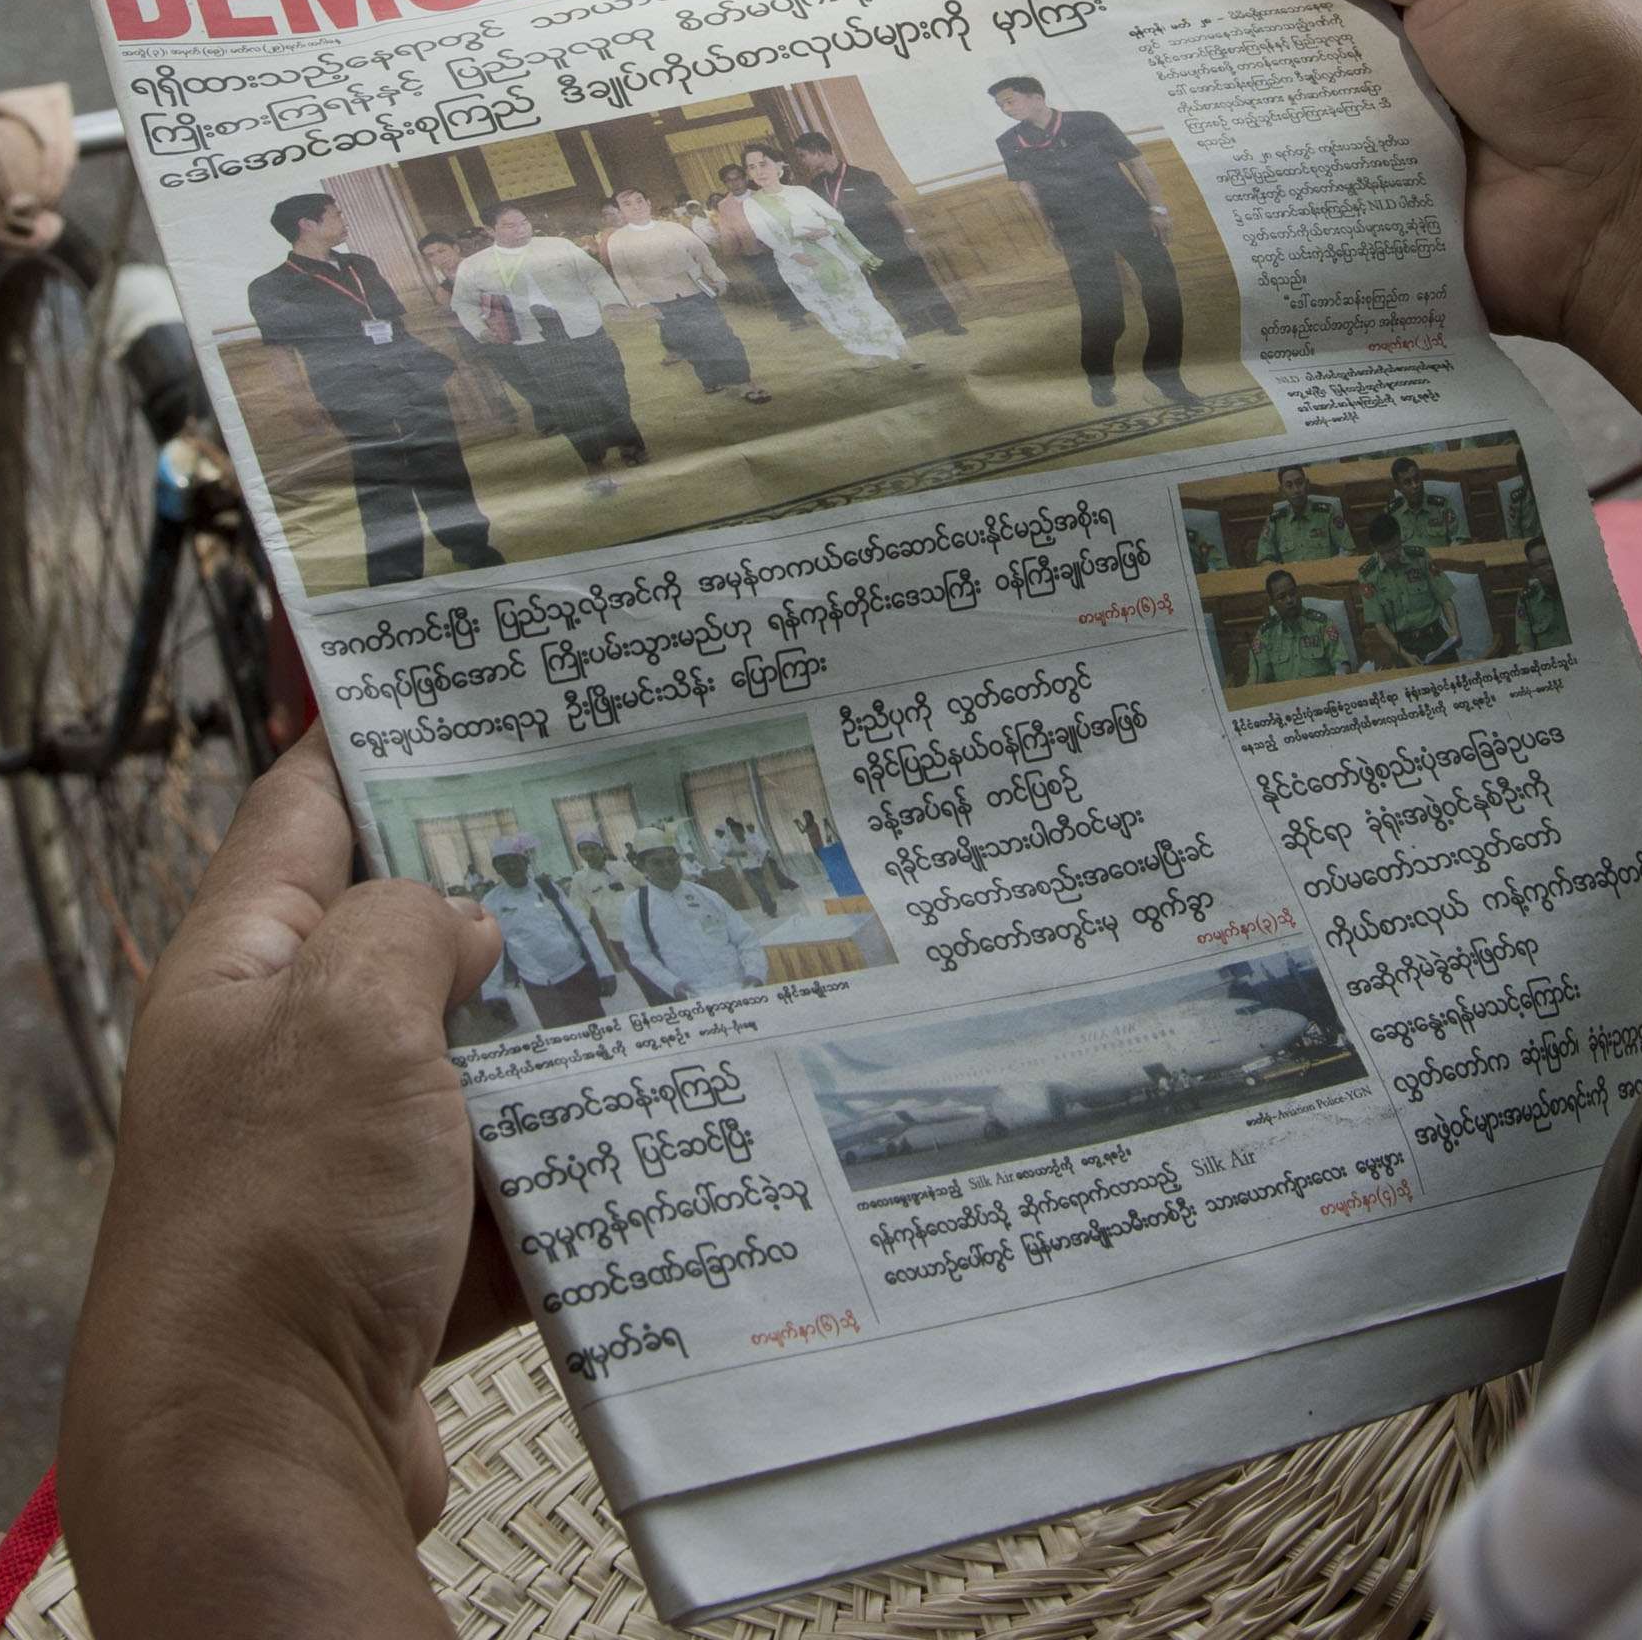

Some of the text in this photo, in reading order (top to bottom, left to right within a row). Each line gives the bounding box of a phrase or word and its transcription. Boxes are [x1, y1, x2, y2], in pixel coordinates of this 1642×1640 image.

[130, 19, 506, 108] ရရှိထားသည့်နေရာတွင်
[140, 69, 424, 157] ကြိုးစားကြရန်နှင့်
[445, 27, 655, 91] ပြည်သူလူထု
[159, 85, 542, 189] ဒေါ်အောင်ဆန်းစုကြည်
[555, 0, 973, 111] ဒီချုပ်ကိုယ်စားလှယ်များကို
[320, 498, 1118, 657] အဂတိကင်းပြီး ပြည်သူ့လိုအင်ကို အမှန်တကယ်ဖော်ဆောင်ပေးနိုင်မည့်အစိုးရ
[335, 537, 1152, 711] တစ်ရပ်ဖြစ်အောင် ကြိုးပမ်းသွားမည်ဟု ရန်ကုန်တိုင်းဒေသကြီး ဝန်ကြီးချုပ်အဖြစ်
[349, 645, 828, 759] ရွေးချယ်ခံထားရသူ ဦးဖြိုးမင်းသိန်း ပြောကြား
[838, 660, 1093, 749] ဦးညီပုကို လွှတ်တော်တွင်
[852, 699, 1148, 796] ရခိုင်ပြည်နယ်ဝန်ကြီးချုပ်အဖြစ်
[1257, 725, 1566, 812] နိုင်ငံတော်ဖွဲ့စည်းပုံအခြေခံဥပဒေ
[866, 763, 1084, 841] ခန့်အပ်ရန် တင်ပြစဉ်
[1281, 768, 1555, 858] ဆိုင်ရာ ခုံရုံးအဖွဲ့ဝင်နှစ်ဦးကို
[884, 806, 1146, 886] ရခိုင်အမျိုးသားပါတီဝင်များ
[905, 830, 1215, 927] လွှတ်တော်အစည်းအဝေးမပြီးခင်
[1303, 817, 1563, 900] တပ်မတော်သားလွှတ်တော်
[925, 886, 1215, 973] လွှတ်တော်အတွင်းမှ ထွက်ခွာ
[1324, 888, 1470, 958] ကိုယ်စားလှယ်
[1346, 931, 1540, 1000] အဆိုကိုမဲခွဲဆုံးဖြတ်ရာ
[1369, 972, 1582, 1050] ဆွေးနွေးရန်မသင့်ကြောင်း
[478, 1059, 747, 1143] ဒေါ်အောင်ဆန်းစုကြည်
[1393, 1048, 1511, 1103] လွှတ်တော်က
[1520, 1028, 1580, 1080] ဆုံးဖြတ်၊
[1413, 1069, 1607, 1153] အဖွဲ့ဝင်များအမည်စာရင်းကို
[499, 1116, 755, 1198] ဓာတ်ပုံကို ပြင်ဆင်ပြီး
[967, 1174, 993, 1191] Silk
[995, 1171, 1016, 1186] Air
[1354, 1151, 1406, 1181] မွေးဖွား
[520, 1173, 814, 1265] လူမှုကွန်ရက်ပေါ်တင်ခဲ့သူ
[869, 1145, 1258, 1257] ရန်ကုန်လေဆိပ်သို့ ဆိုက်ရောက်လာသည့် Silk Air
[543, 1233, 799, 1314] ထောင်ဒဏ်ခြောက်လ
[566, 1323, 690, 1381] ချမှတ်ခံရ
